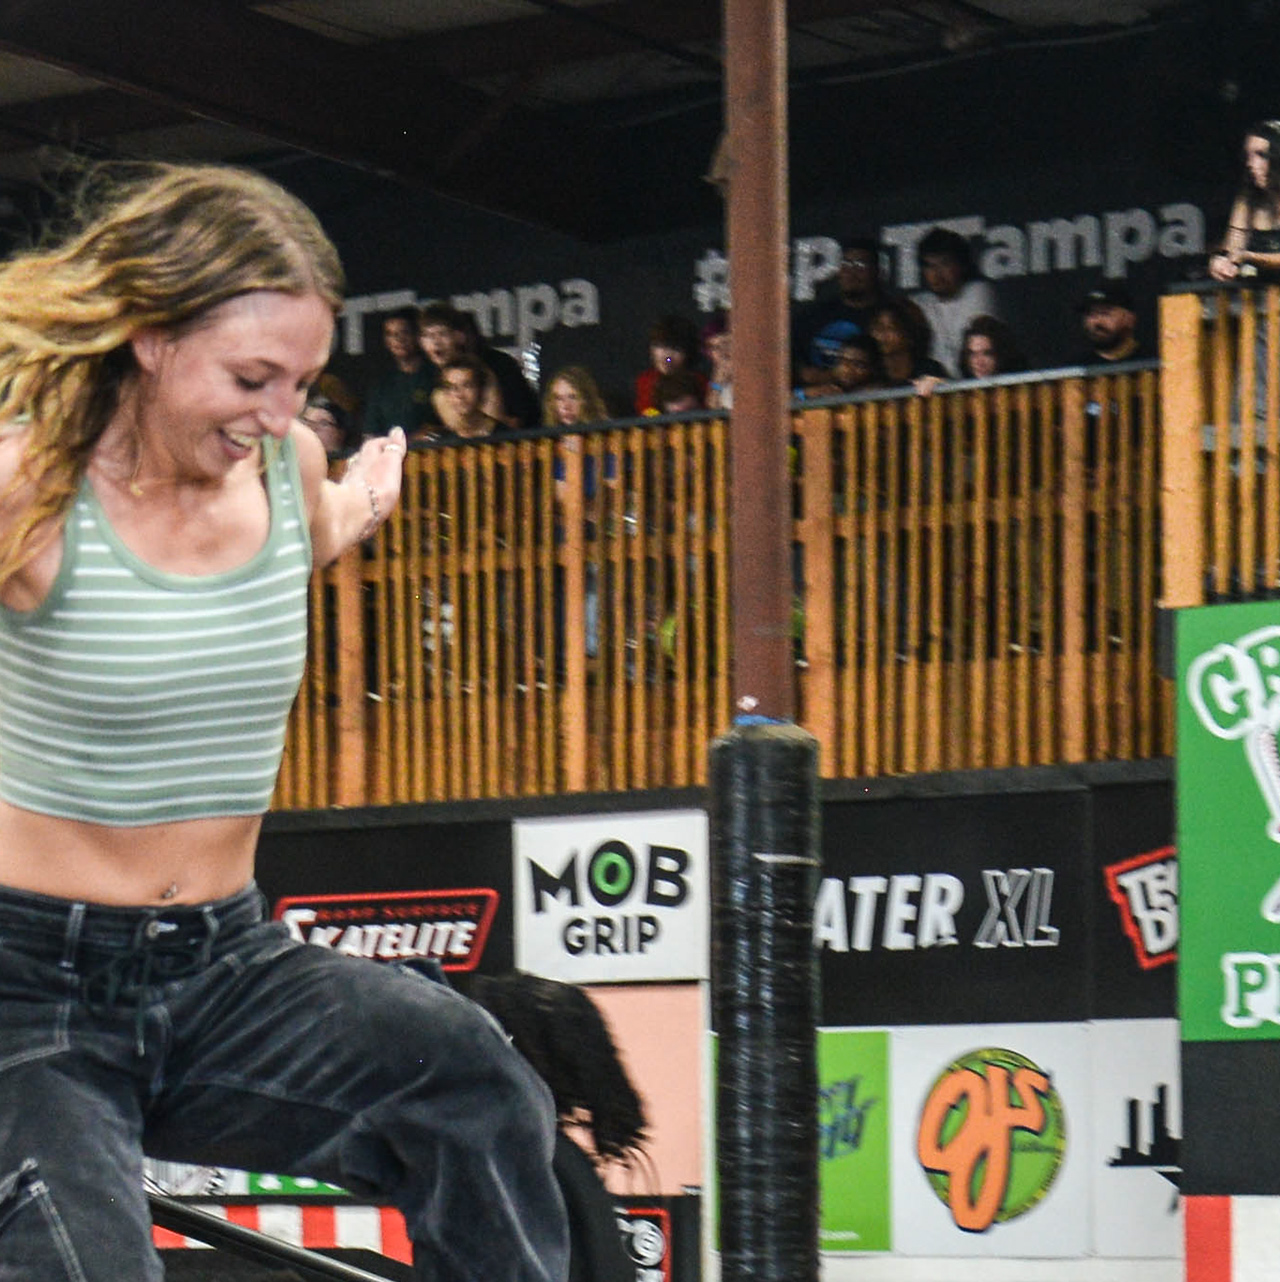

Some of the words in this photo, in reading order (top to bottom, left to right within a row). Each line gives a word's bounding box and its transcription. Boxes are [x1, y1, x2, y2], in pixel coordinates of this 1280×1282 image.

[527, 840, 694, 915] MOB
[281, 908, 477, 959] SKATELITE
[562, 916, 662, 957] GRIP
[811, 871, 966, 952] ATER
[972, 867, 1060, 949] XL
